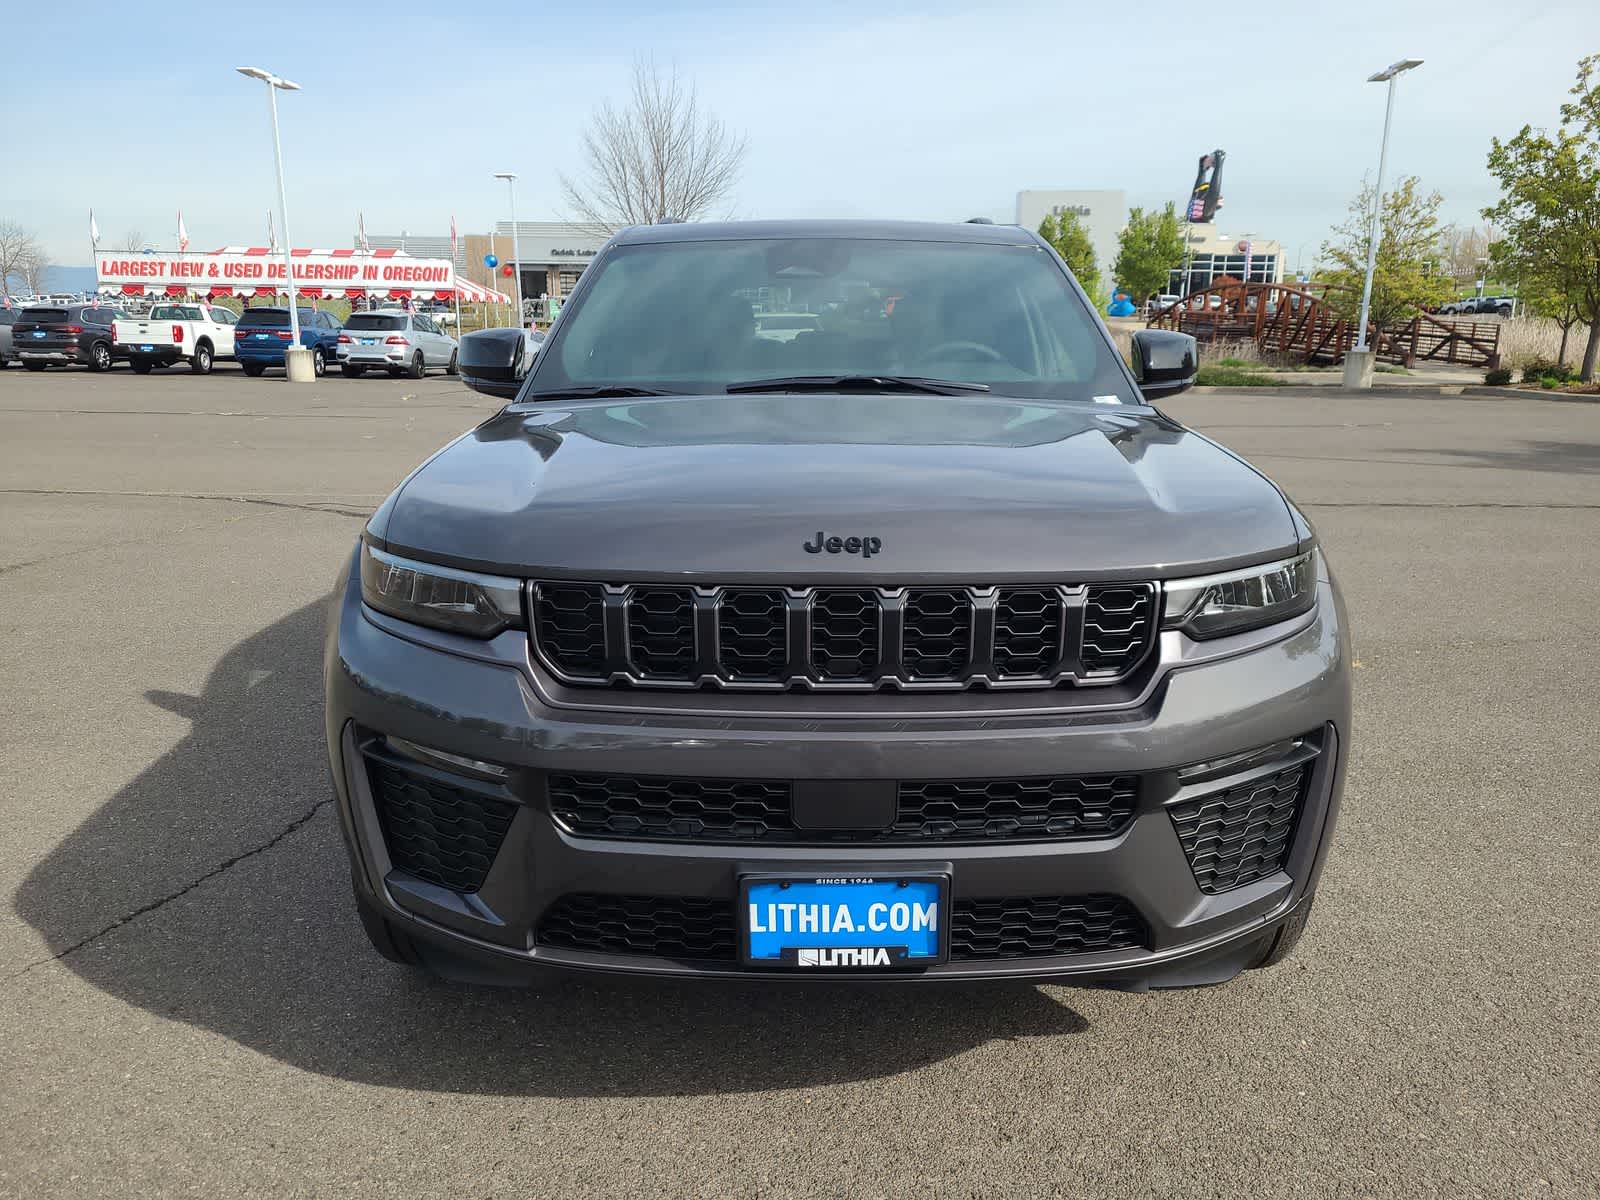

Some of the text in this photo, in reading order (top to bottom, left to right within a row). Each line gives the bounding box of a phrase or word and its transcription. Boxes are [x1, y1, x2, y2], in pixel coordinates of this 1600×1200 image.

[101, 260, 166, 276] LARGEST
[170, 262, 204, 277] NEW
[207, 262, 220, 278] &
[223, 262, 263, 278] USED
[362, 265, 378, 280] IN
[382, 265, 449, 282] OREGON!
[803, 531, 882, 558] Jeep
[749, 902, 938, 934] LITHIA.COM
[819, 948, 891, 966] LITHIA
